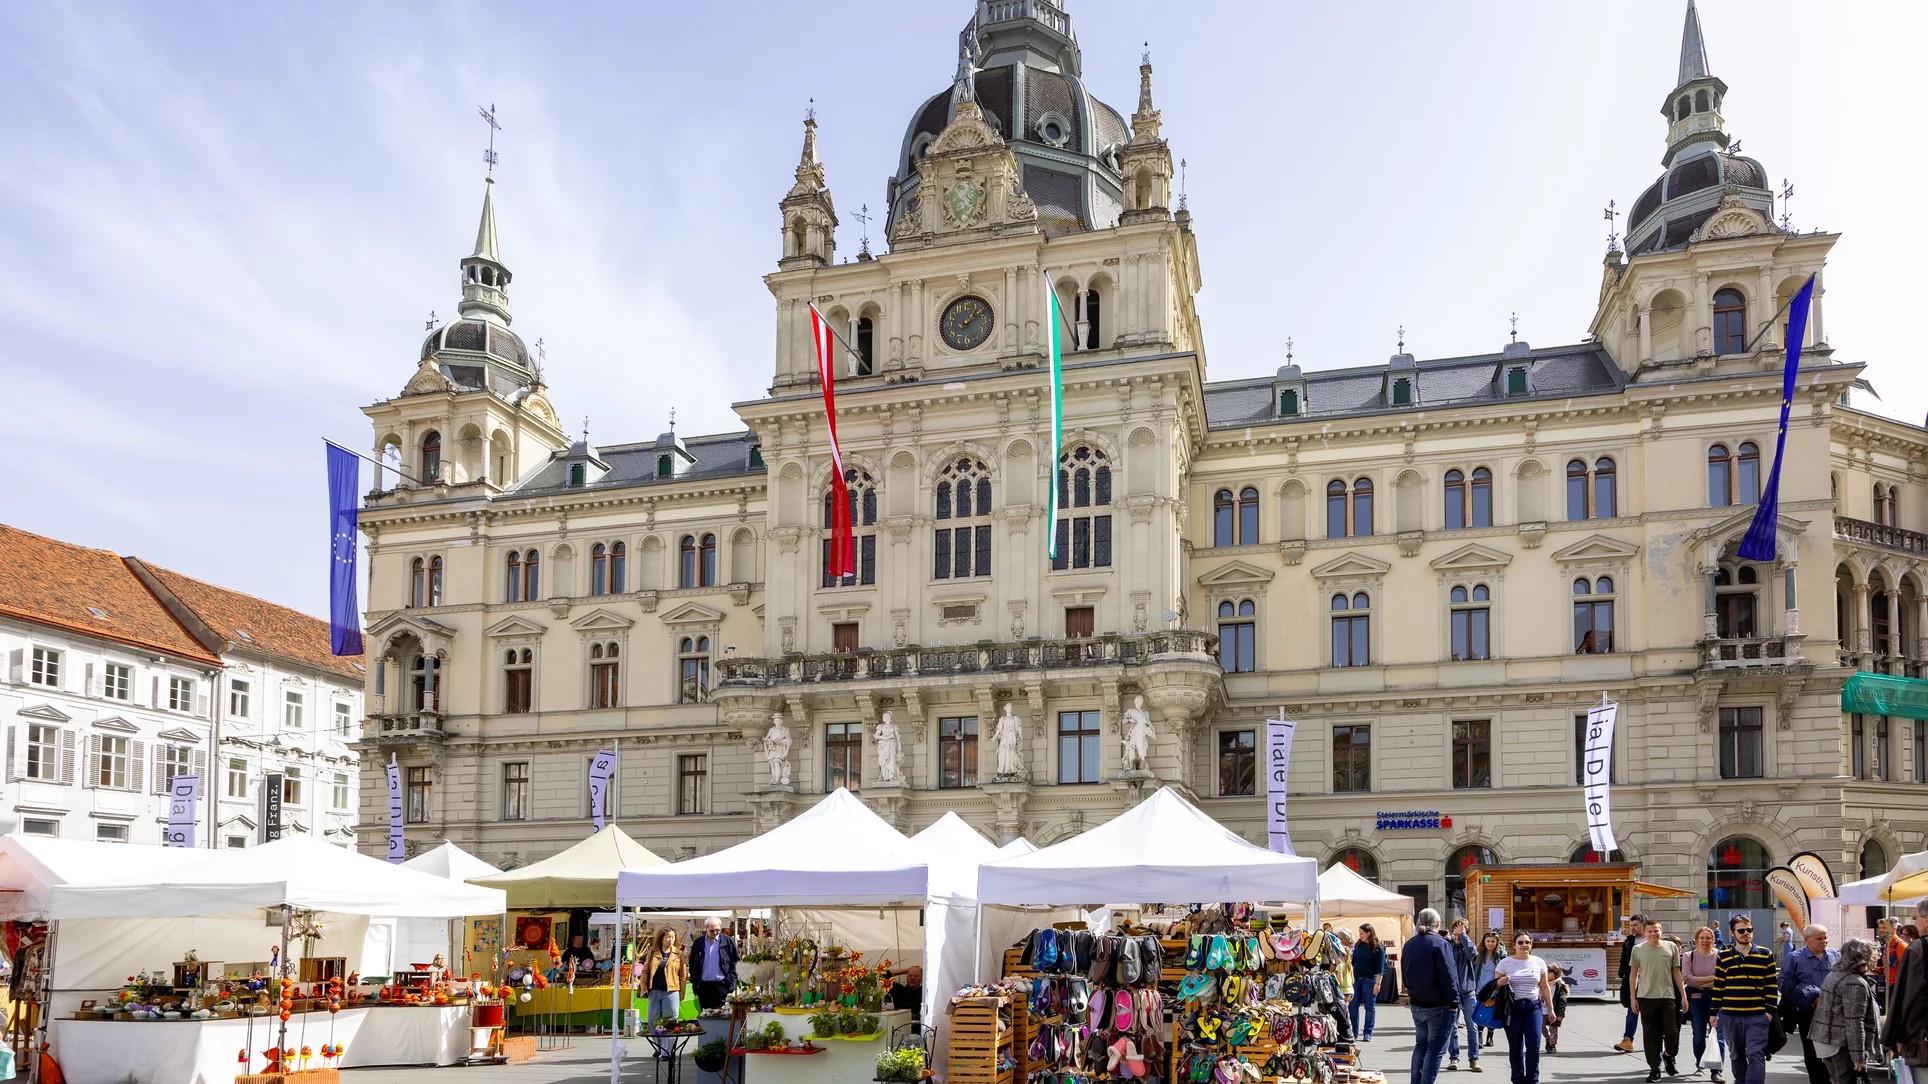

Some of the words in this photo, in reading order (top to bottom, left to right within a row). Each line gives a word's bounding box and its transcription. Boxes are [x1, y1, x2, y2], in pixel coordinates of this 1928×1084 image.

[172, 785, 193, 815] Dia
[268, 784, 278, 826] Franz.
[1376, 810, 1440, 819] Steiermärkische
[1376, 818, 1440, 830] SPARKASSE
